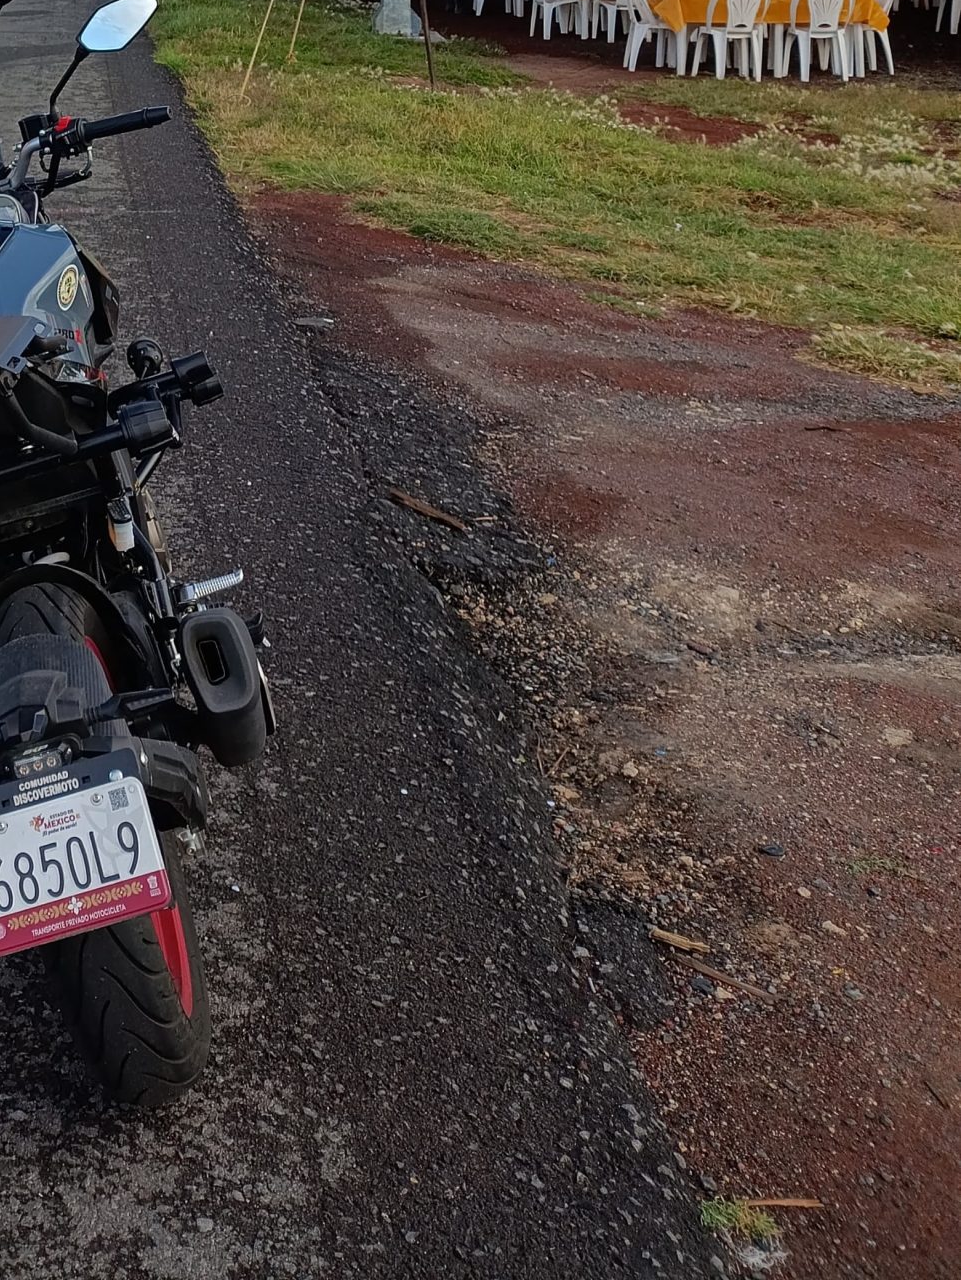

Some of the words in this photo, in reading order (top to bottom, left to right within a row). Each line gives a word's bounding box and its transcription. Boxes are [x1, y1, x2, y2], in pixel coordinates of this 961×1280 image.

[12, 778, 80, 806] DISCOVERMOTO
[18, 770, 69, 791] COMUNIDAD
[49, 810, 68, 820] ESTADO
[31, 920, 66, 937] TRANSPORTE
[65, 915, 90, 927] PRIVADO
[89, 903, 127, 920] MOTOCICLETA
